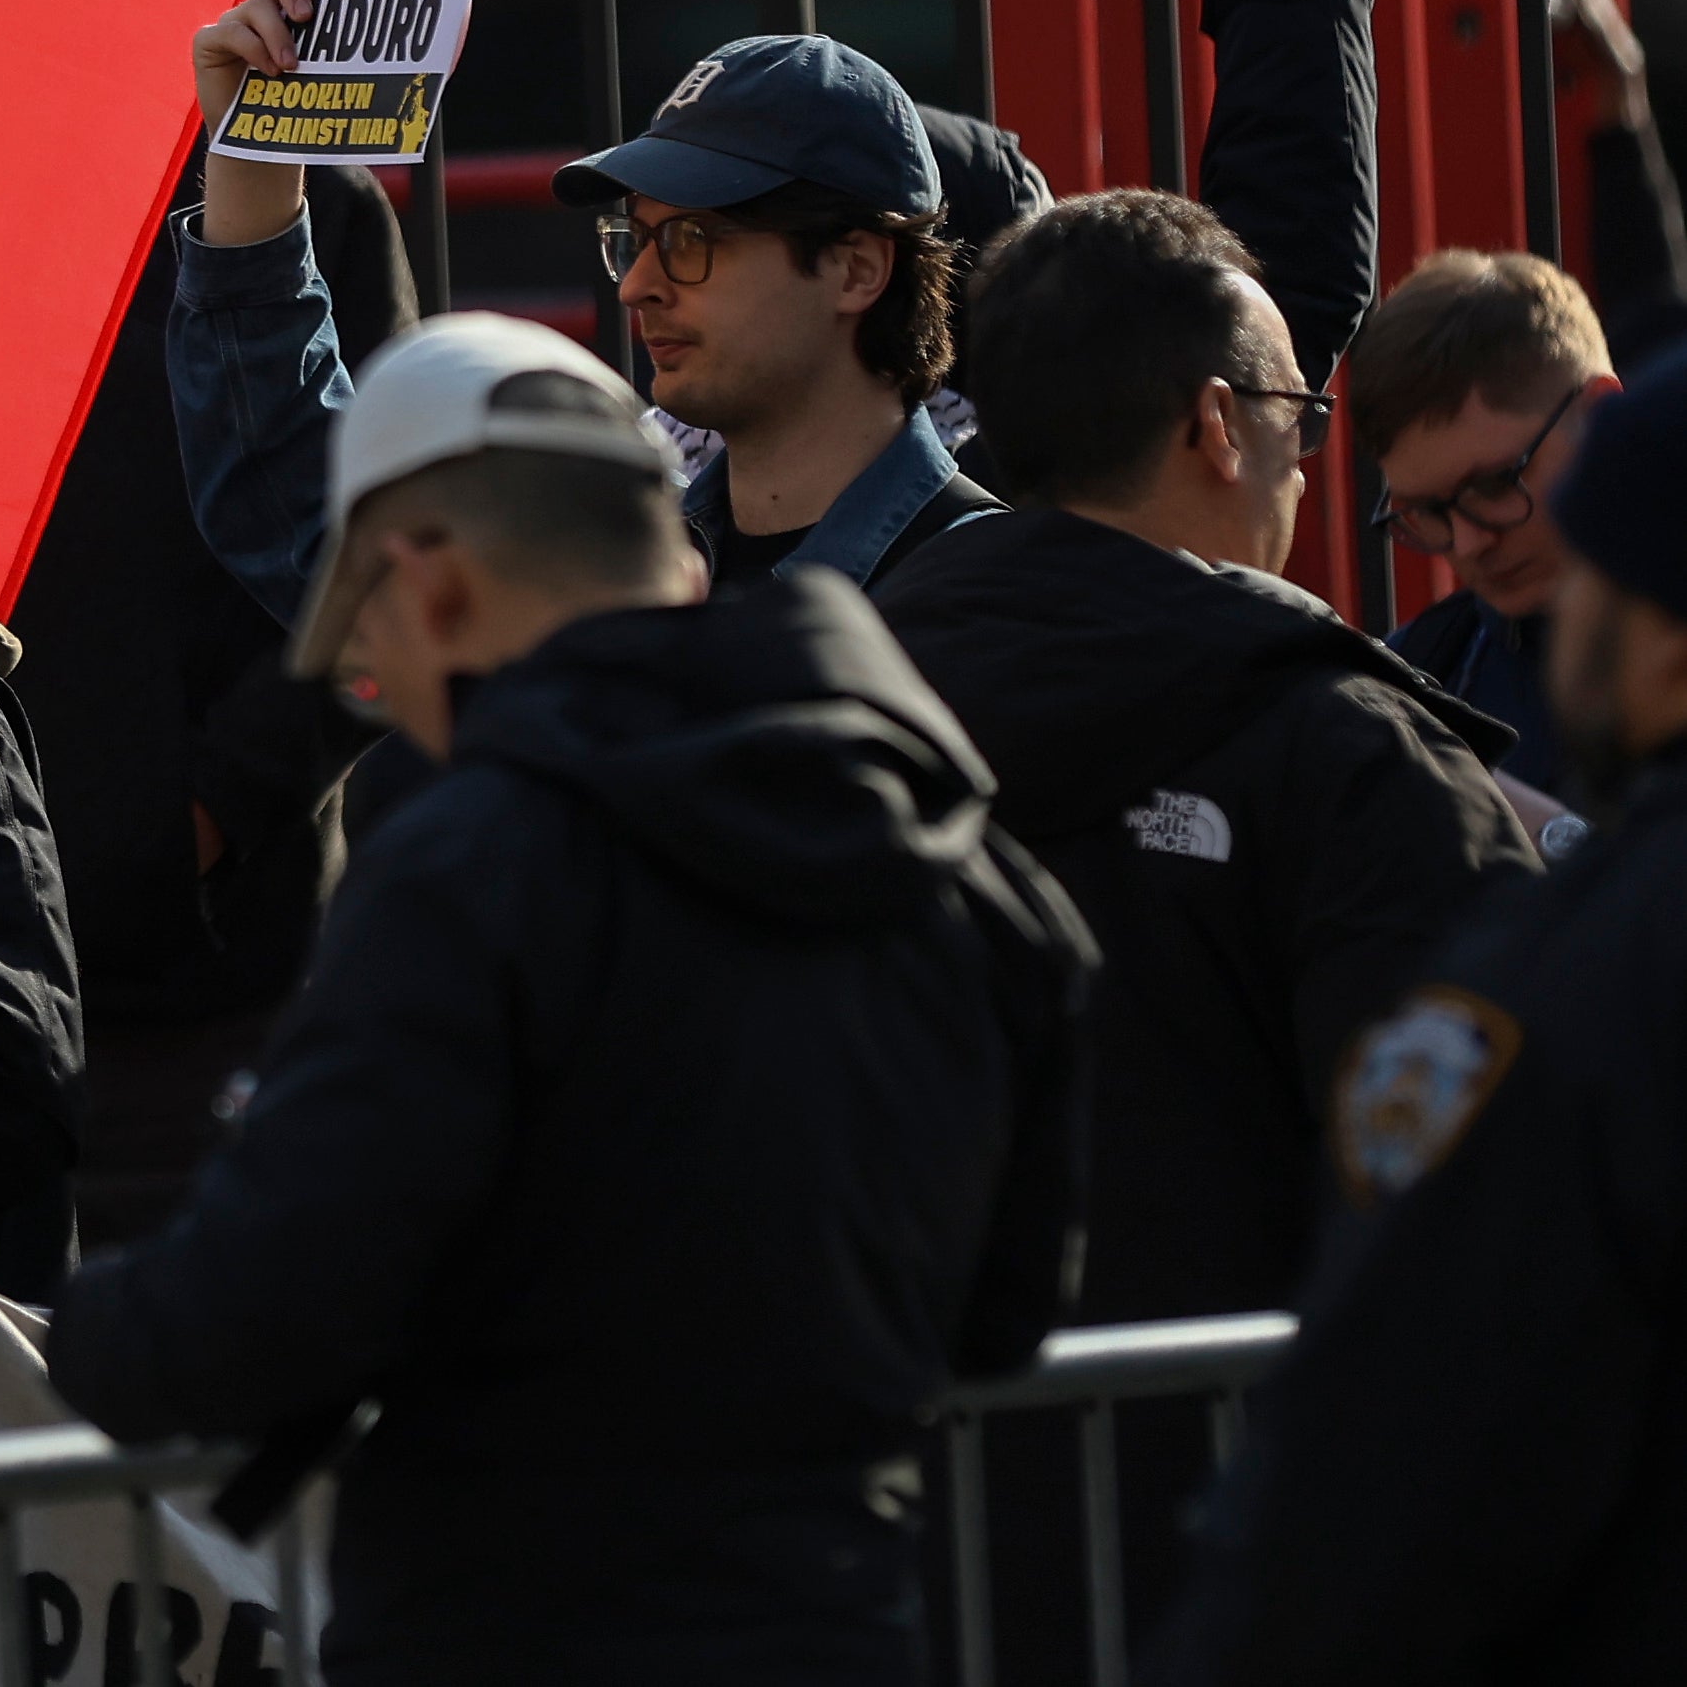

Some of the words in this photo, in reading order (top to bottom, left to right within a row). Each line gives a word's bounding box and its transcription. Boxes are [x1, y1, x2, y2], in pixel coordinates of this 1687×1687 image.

[242, 79, 376, 110] BROOKLYN
[228, 112, 347, 145] AGAINST
[348, 118, 399, 146] WAR
[1155, 790, 1198, 814] THE
[1125, 809, 1193, 834] NORTH
[1141, 831, 1191, 854] FACE
